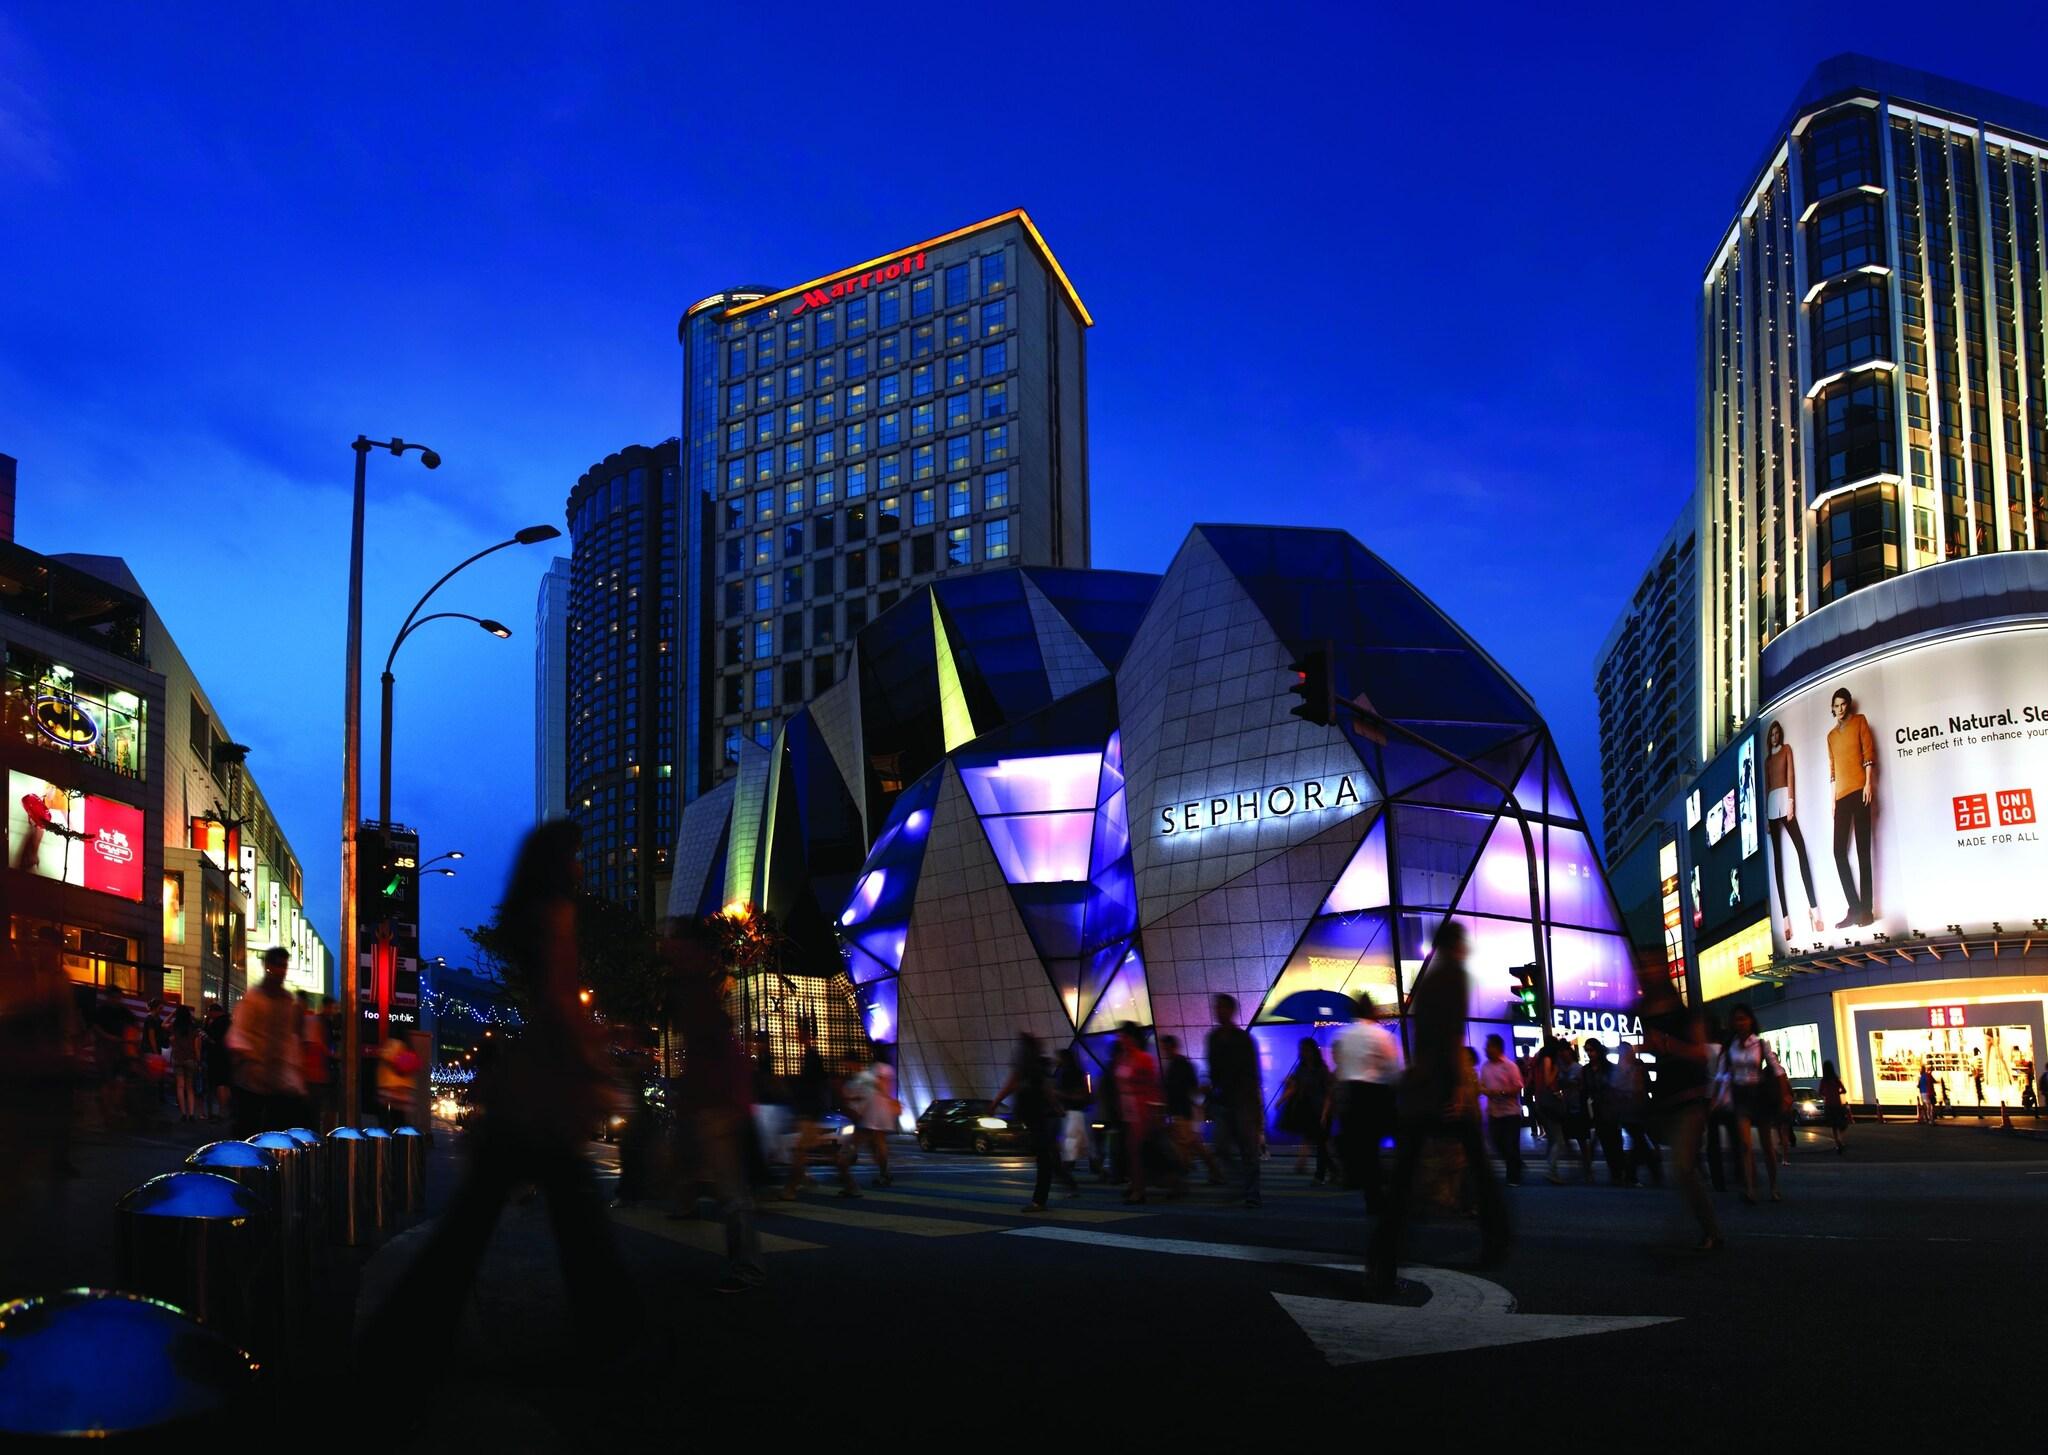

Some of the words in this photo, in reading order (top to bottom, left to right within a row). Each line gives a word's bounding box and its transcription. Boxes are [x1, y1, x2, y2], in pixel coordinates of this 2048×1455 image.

[792, 252, 927, 315] Marriott
[1895, 725, 1944, 745] Clean.
[1949, 709, 2018, 733] Natural.
[2023, 706, 2048, 723] Sle
[1897, 748, 1913, 758] The
[1917, 740, 1949, 756] perfect
[1953, 737, 1963, 747] fit
[1967, 736, 1977, 745] to
[1981, 730, 2022, 743] enhance
[1162, 775, 1359, 835] SEPHORA
[1999, 793, 2028, 808] UNI
[2002, 807, 2031, 823] QLO
[1957, 836, 1986, 847] MADE
[1992, 834, 2012, 844] FOR
[2017, 832, 2039, 842] ALL
[364, 1010, 380, 1020] foo
[388, 1012, 414, 1022] public
[1553, 1009, 1643, 1035] EPHORA
